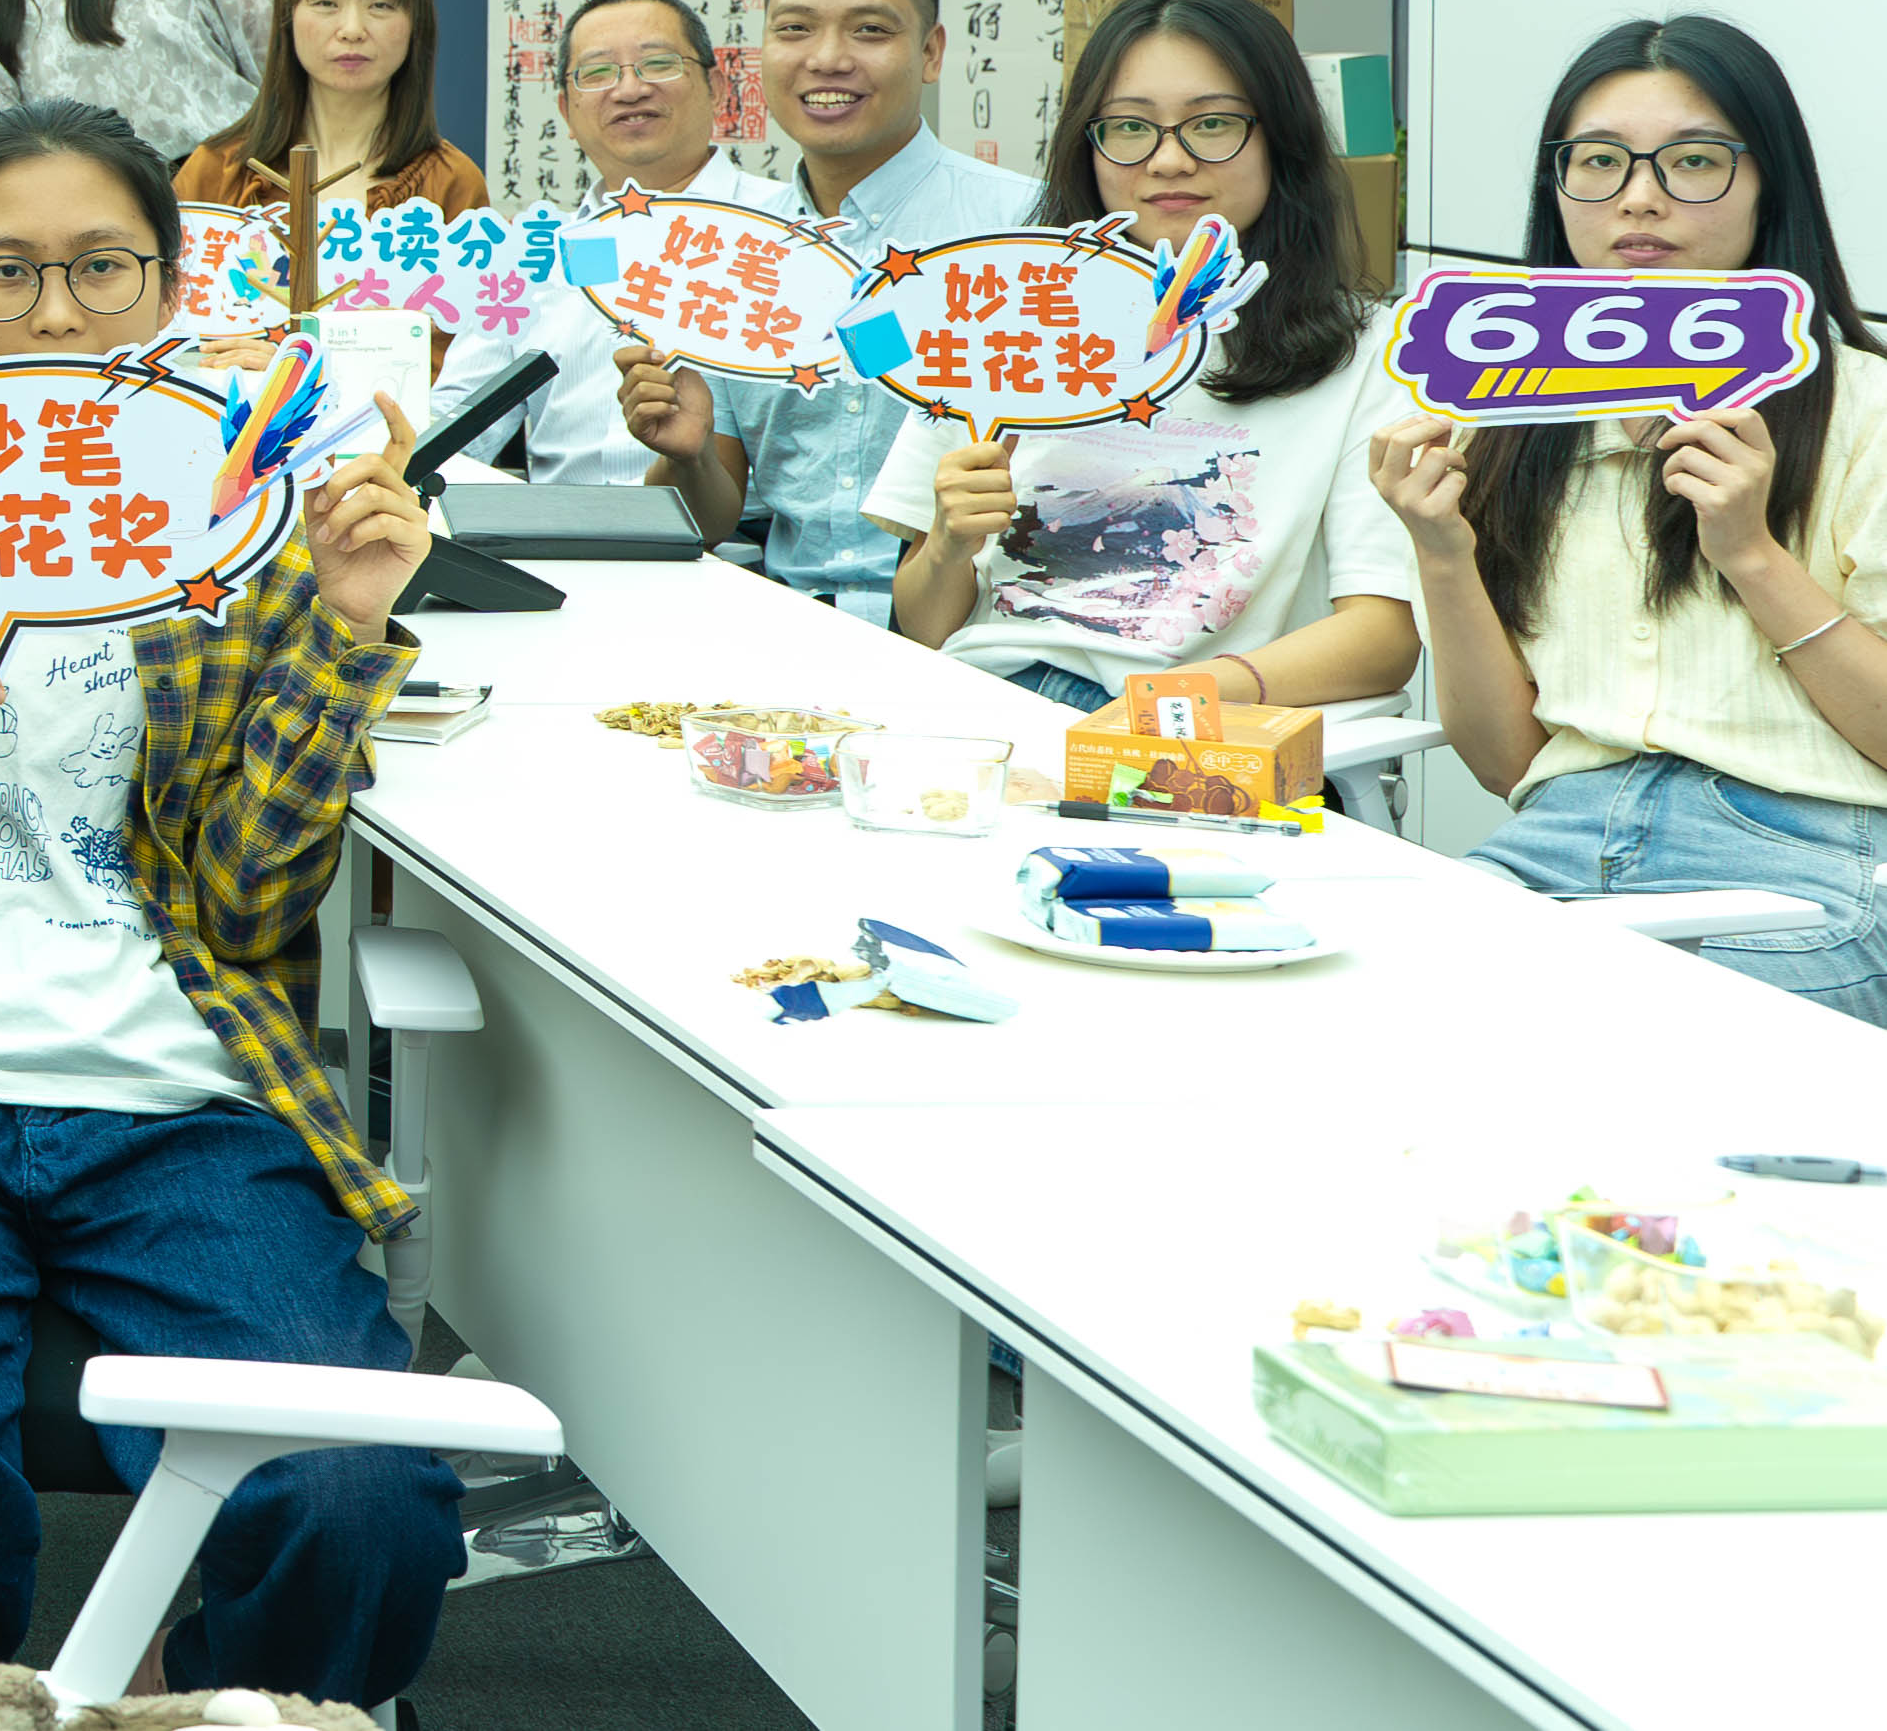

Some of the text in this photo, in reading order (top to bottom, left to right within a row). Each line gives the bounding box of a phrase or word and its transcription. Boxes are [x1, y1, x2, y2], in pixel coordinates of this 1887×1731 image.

[659, 214, 793, 297] 妙笔
[616, 260, 803, 360] 生花奖
[944, 261, 1081, 329] 妙笔
[1445, 291, 1746, 365] 666
[916, 330, 1118, 398] 生花奖
[1156, 417, 1251, 441] ountain
[45, 641, 114, 687] Heart
